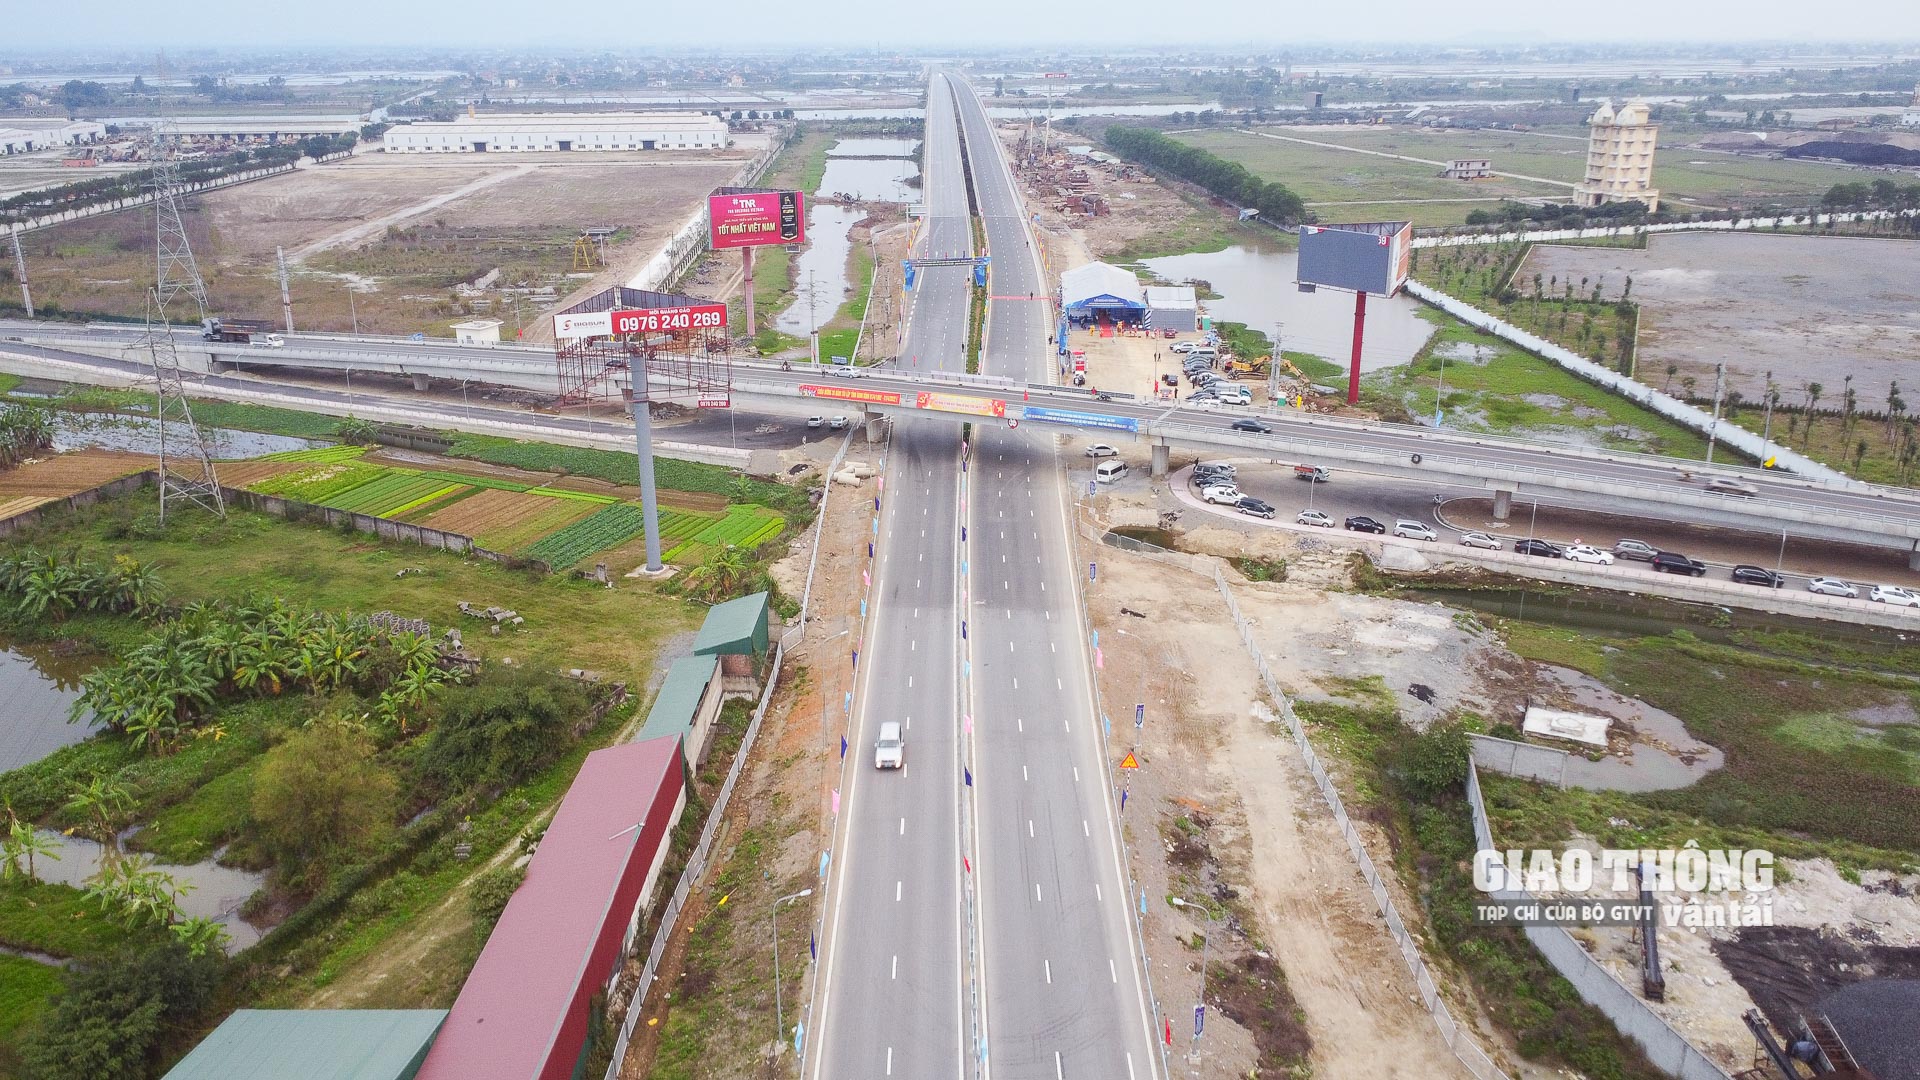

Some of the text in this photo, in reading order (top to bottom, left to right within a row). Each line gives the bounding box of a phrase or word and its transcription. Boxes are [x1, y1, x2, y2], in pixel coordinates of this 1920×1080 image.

[739, 199, 756, 208] TNR
[718, 221, 776, 235] TỐT NHẤT VIỆT NAM
[619, 312, 721, 332] 0976 240 269
